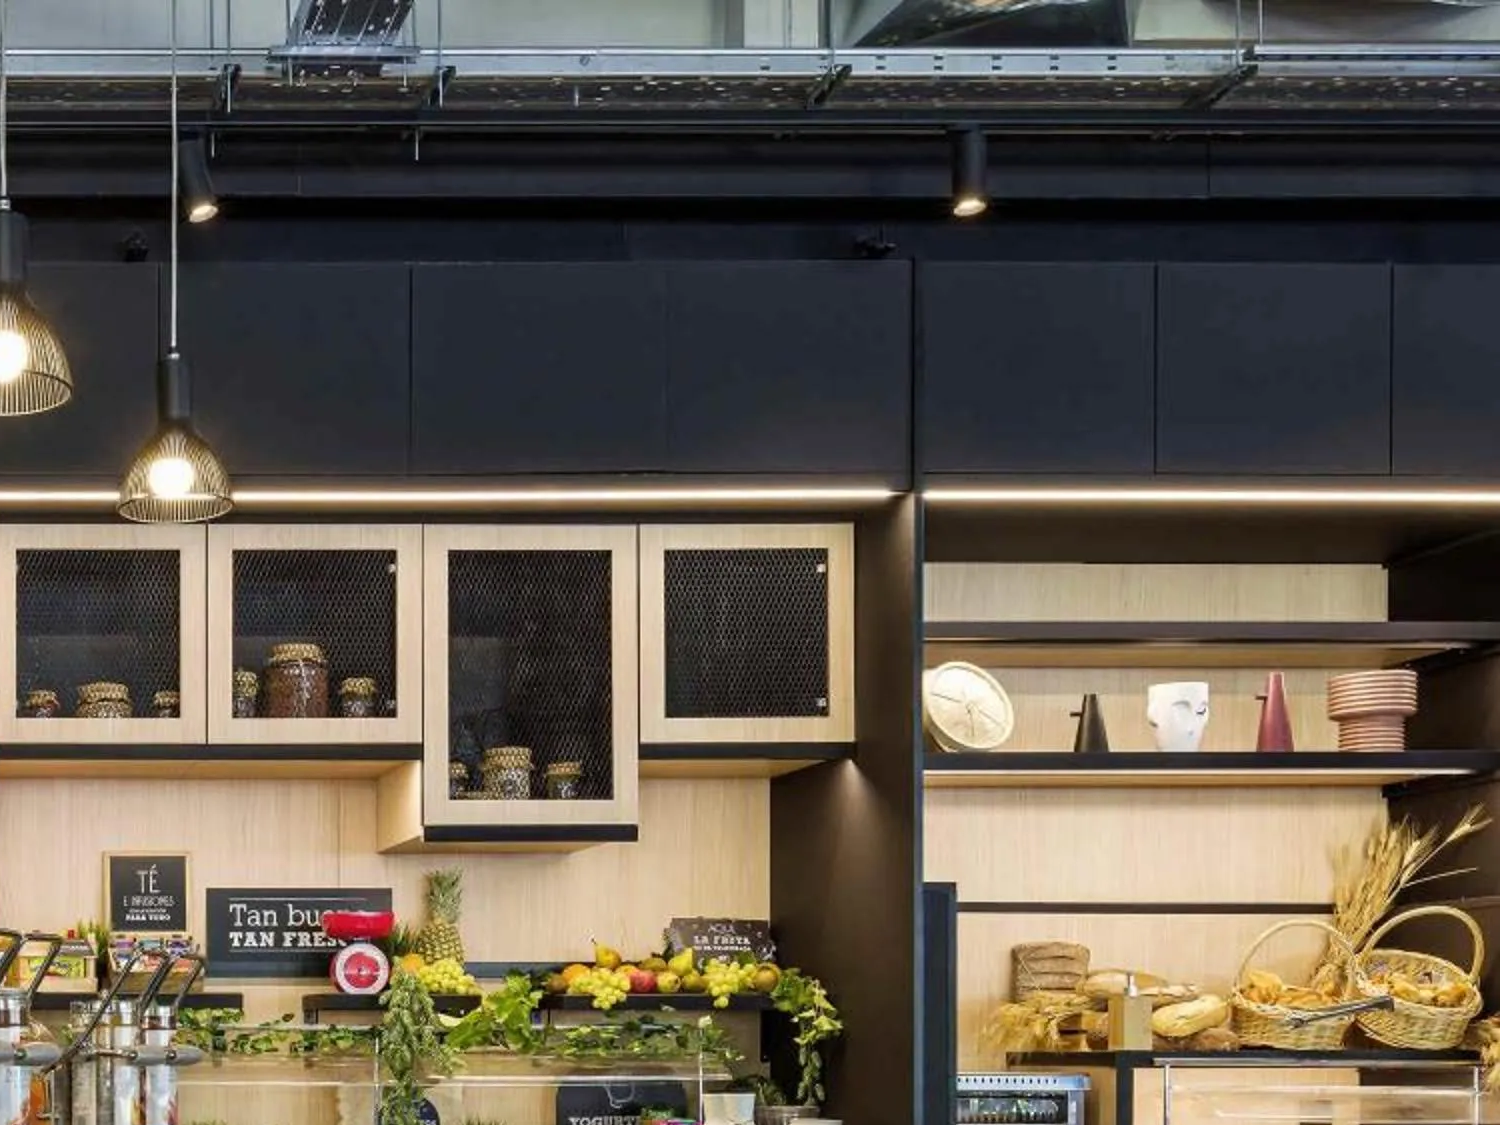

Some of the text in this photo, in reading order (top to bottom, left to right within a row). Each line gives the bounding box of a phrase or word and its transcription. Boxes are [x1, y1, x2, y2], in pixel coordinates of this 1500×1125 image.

[136, 863, 161, 893] TÉ
[229, 903, 278, 927] Tan
[229, 931, 275, 947] TAN
